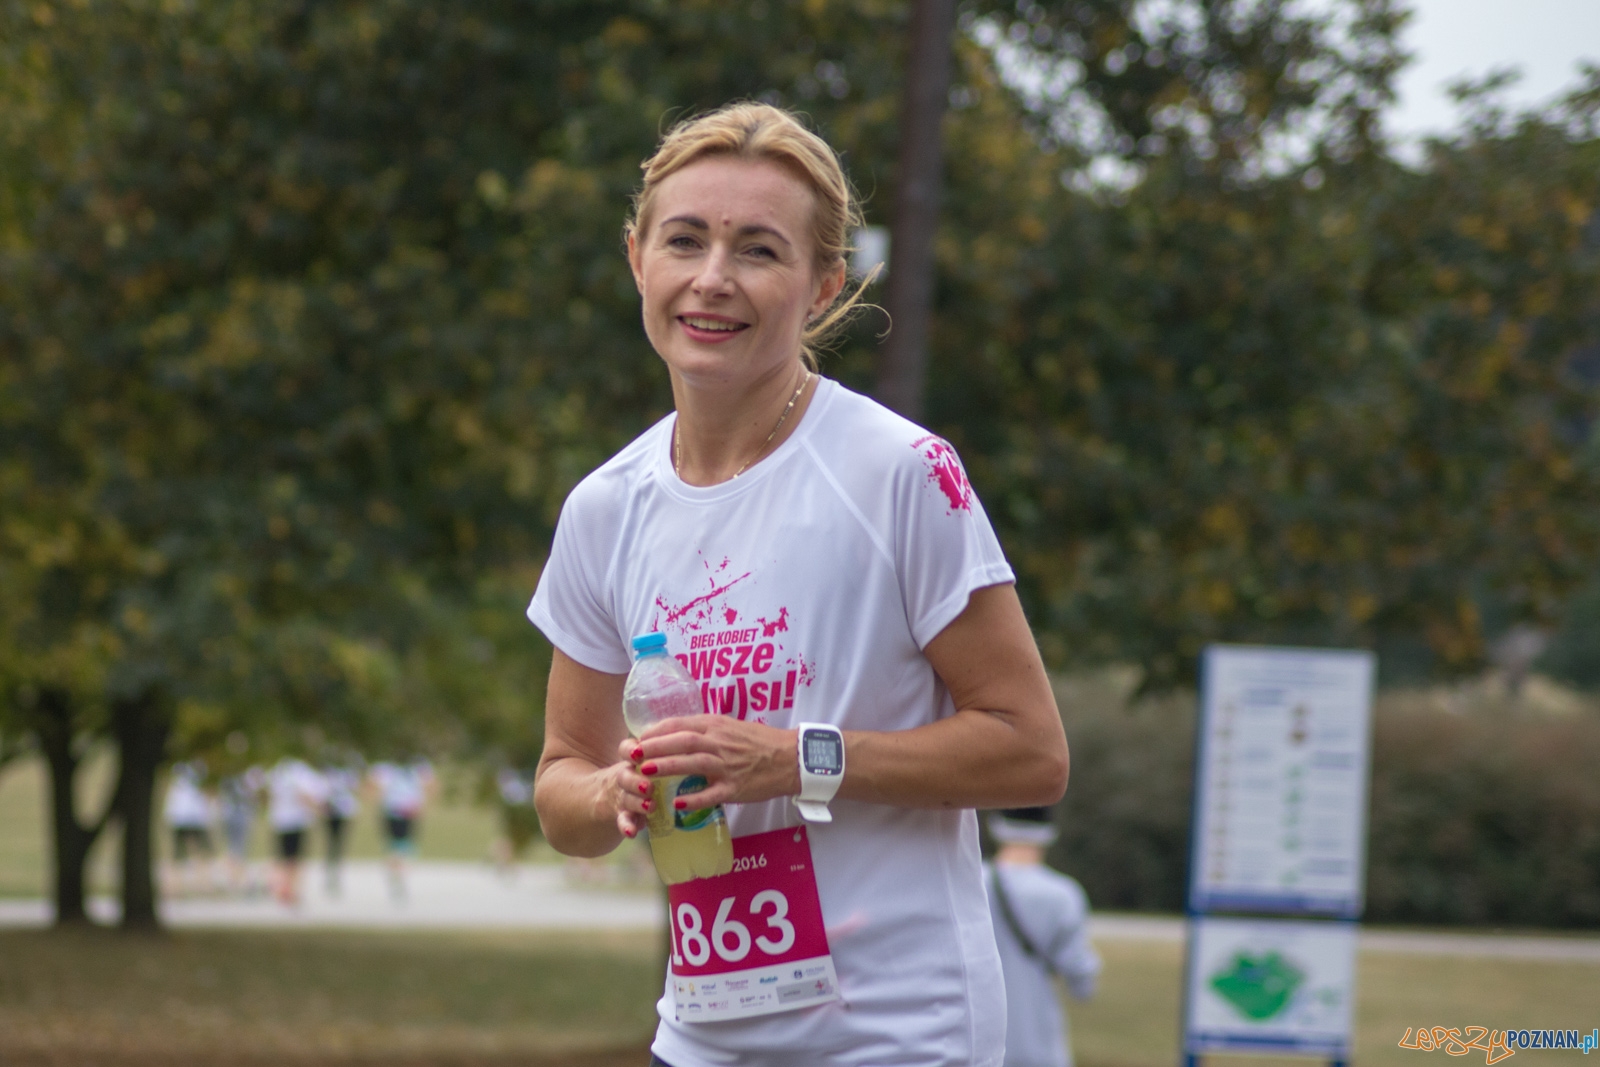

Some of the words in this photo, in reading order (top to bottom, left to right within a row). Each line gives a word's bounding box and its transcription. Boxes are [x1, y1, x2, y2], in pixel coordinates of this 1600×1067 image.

[690, 632, 715, 649] BIEG
[716, 628, 759, 646] KOBIET
[733, 853, 768, 873] 2016
[669, 889, 796, 967] 1863
